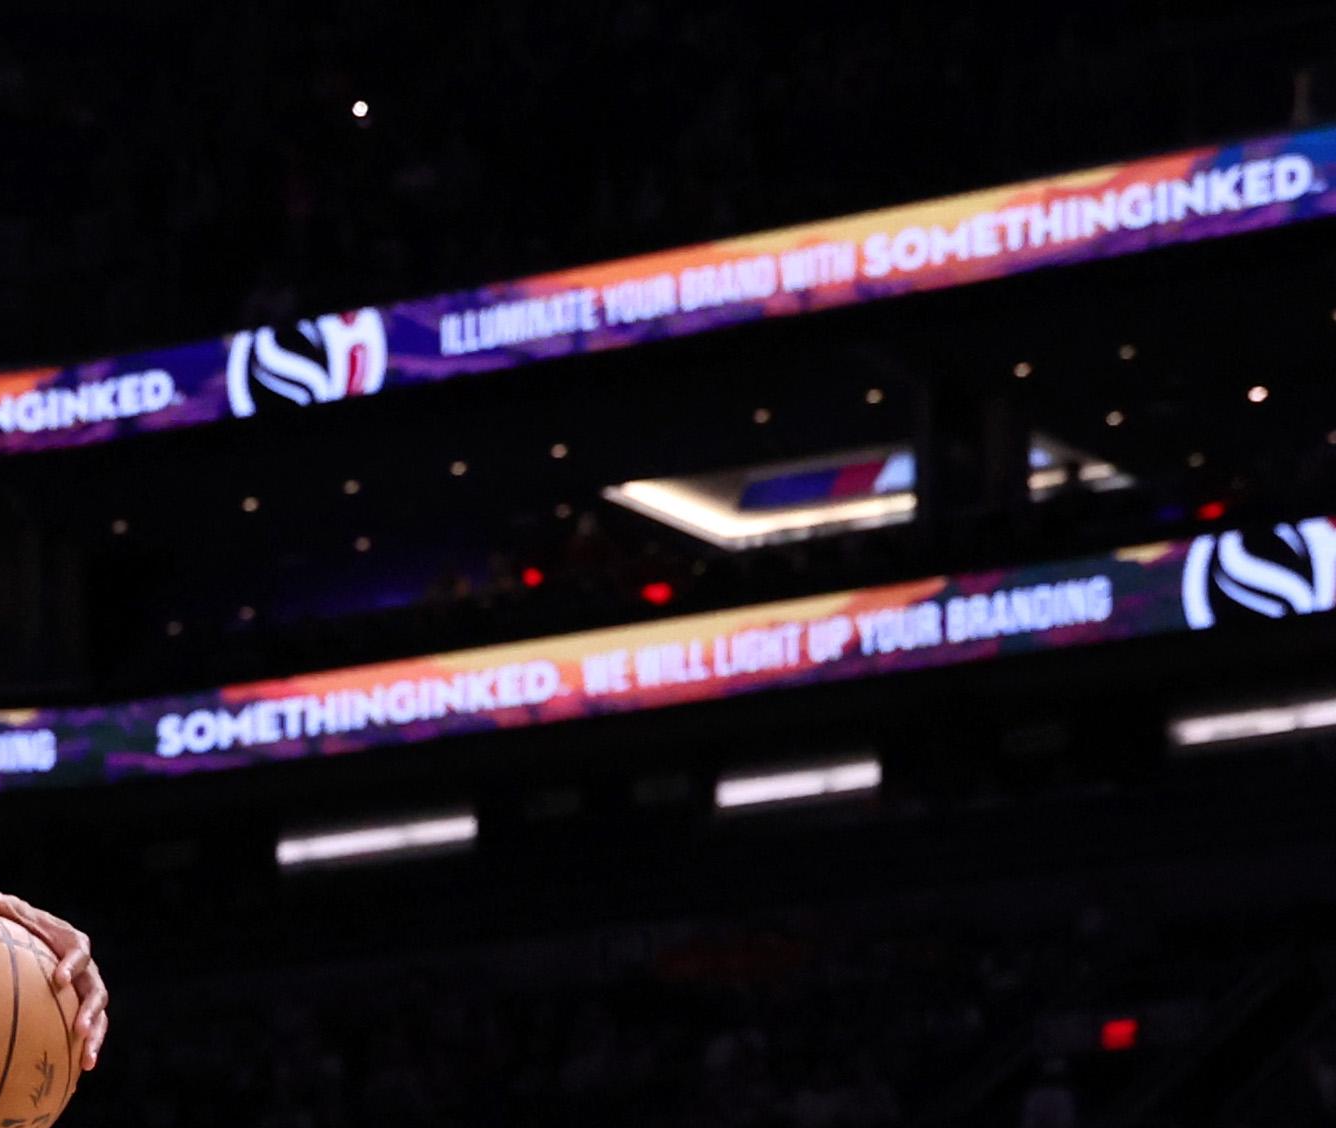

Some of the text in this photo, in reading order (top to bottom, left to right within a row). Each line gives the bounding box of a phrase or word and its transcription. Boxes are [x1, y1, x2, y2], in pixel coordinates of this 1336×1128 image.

[440, 287, 599, 357] ILLUMINATE
[601, 274, 677, 326] YOUR
[679, 254, 778, 312] BRAND
[779, 242, 857, 293] WITH
[581, 650, 630, 697] WE
[633, 635, 712, 689] WILL
[713, 620, 802, 678] LIGHT
[806, 613, 856, 662] UP
[856, 599, 947, 658] YOUR
[947, 575, 1113, 643] BRANDING
